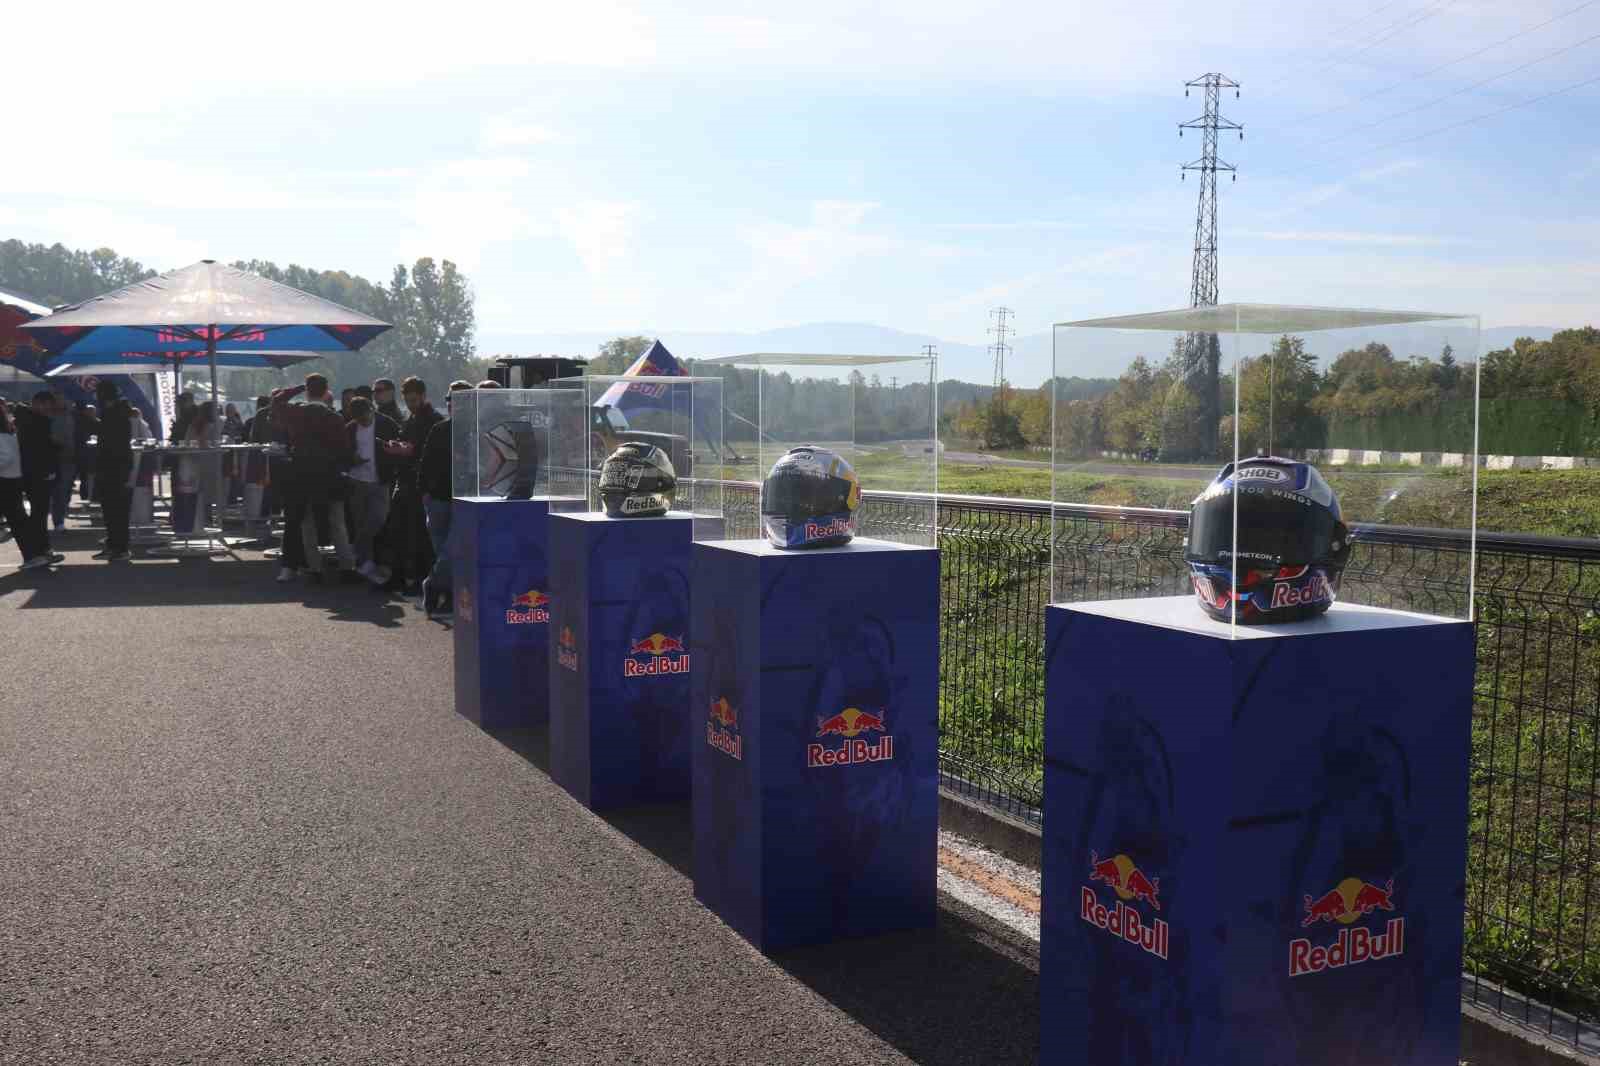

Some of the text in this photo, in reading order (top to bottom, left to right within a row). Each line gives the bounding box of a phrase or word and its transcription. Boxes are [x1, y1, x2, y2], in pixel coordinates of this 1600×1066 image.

[1237, 468, 1281, 479] SHOEI
[626, 497, 648, 511] Red
[805, 519, 834, 540] Red
[1270, 577, 1315, 609] Red
[506, 608, 550, 624] Red Bu
[625, 654, 690, 677] Red Bull
[808, 735, 894, 768] Red Bull
[1081, 886, 1168, 960] Red Bull
[1289, 917, 1404, 976] Red Bull
